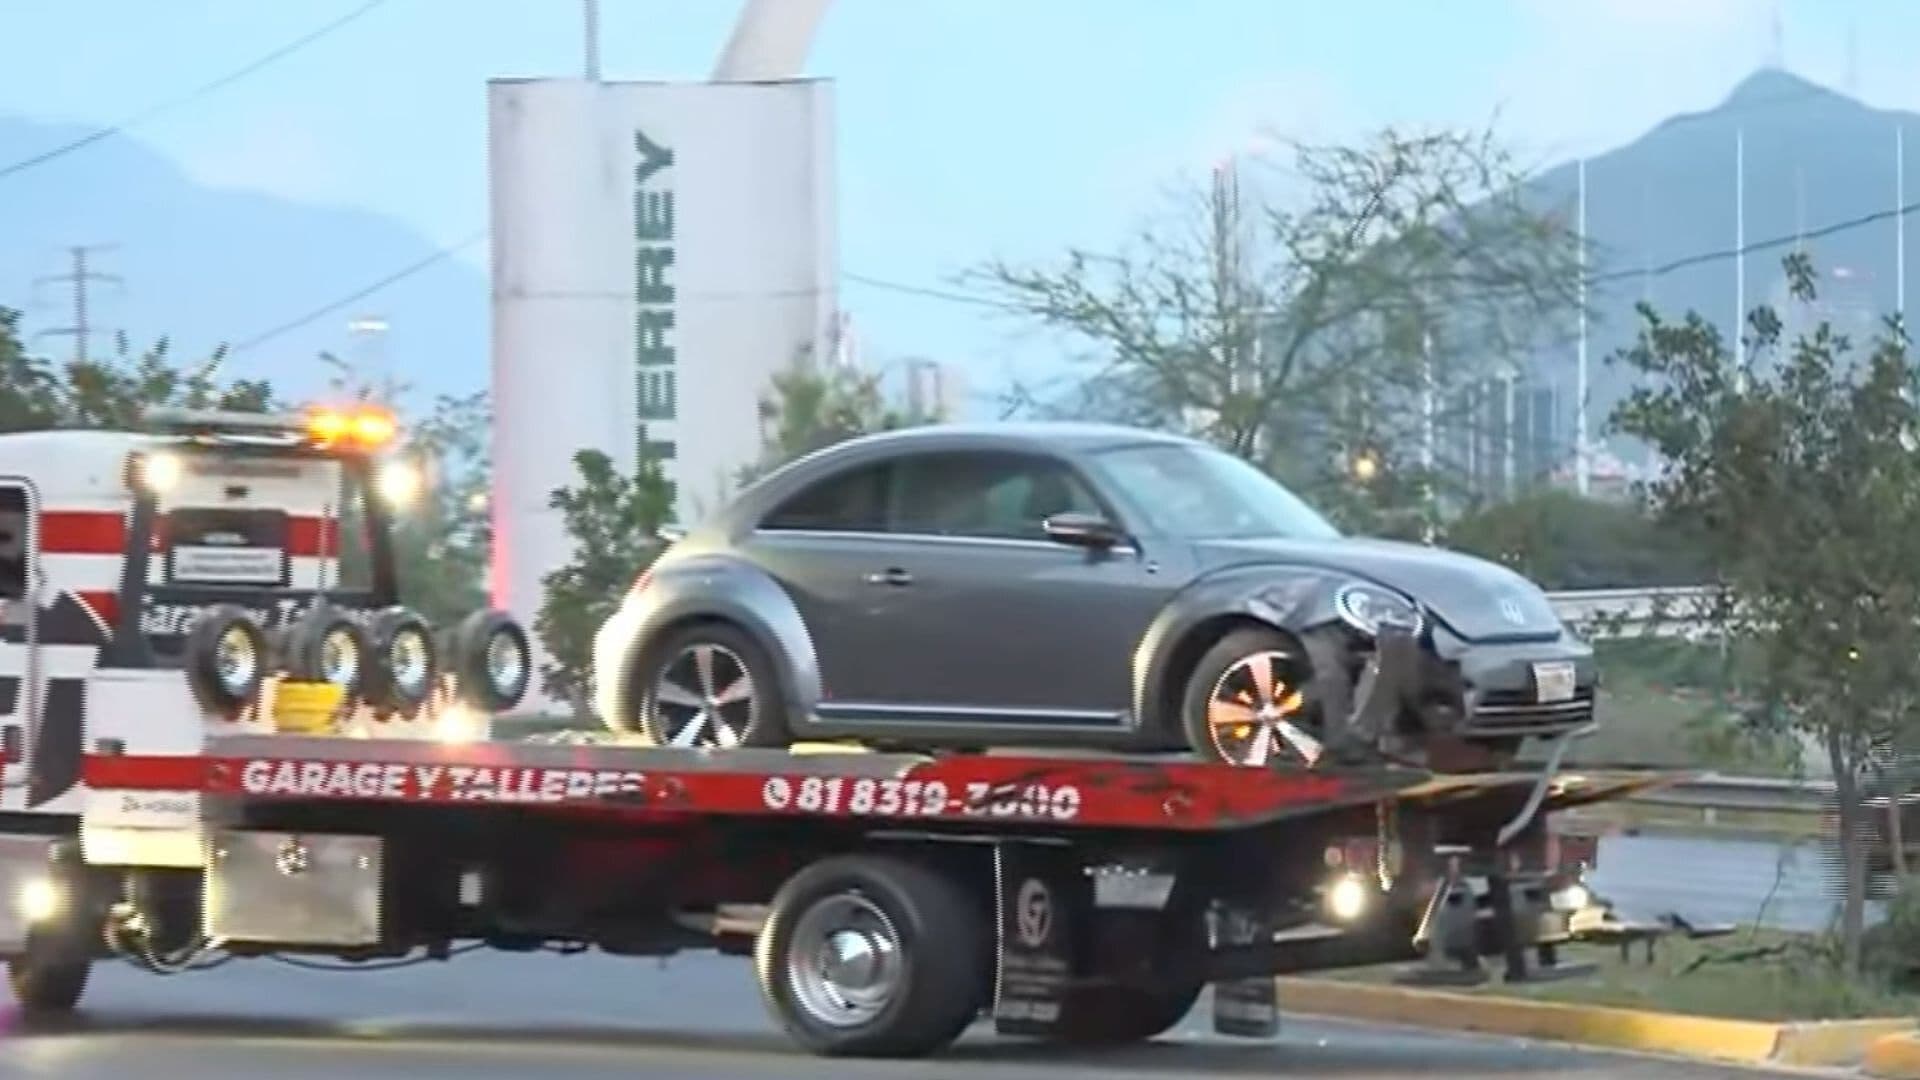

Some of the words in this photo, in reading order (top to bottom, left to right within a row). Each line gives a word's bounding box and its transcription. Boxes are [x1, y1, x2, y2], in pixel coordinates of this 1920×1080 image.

[635, 130, 678, 522] TERREY
[242, 760, 407, 798] GARAGE
[416, 767, 442, 799] Y
[797, 777, 842, 812] 81
